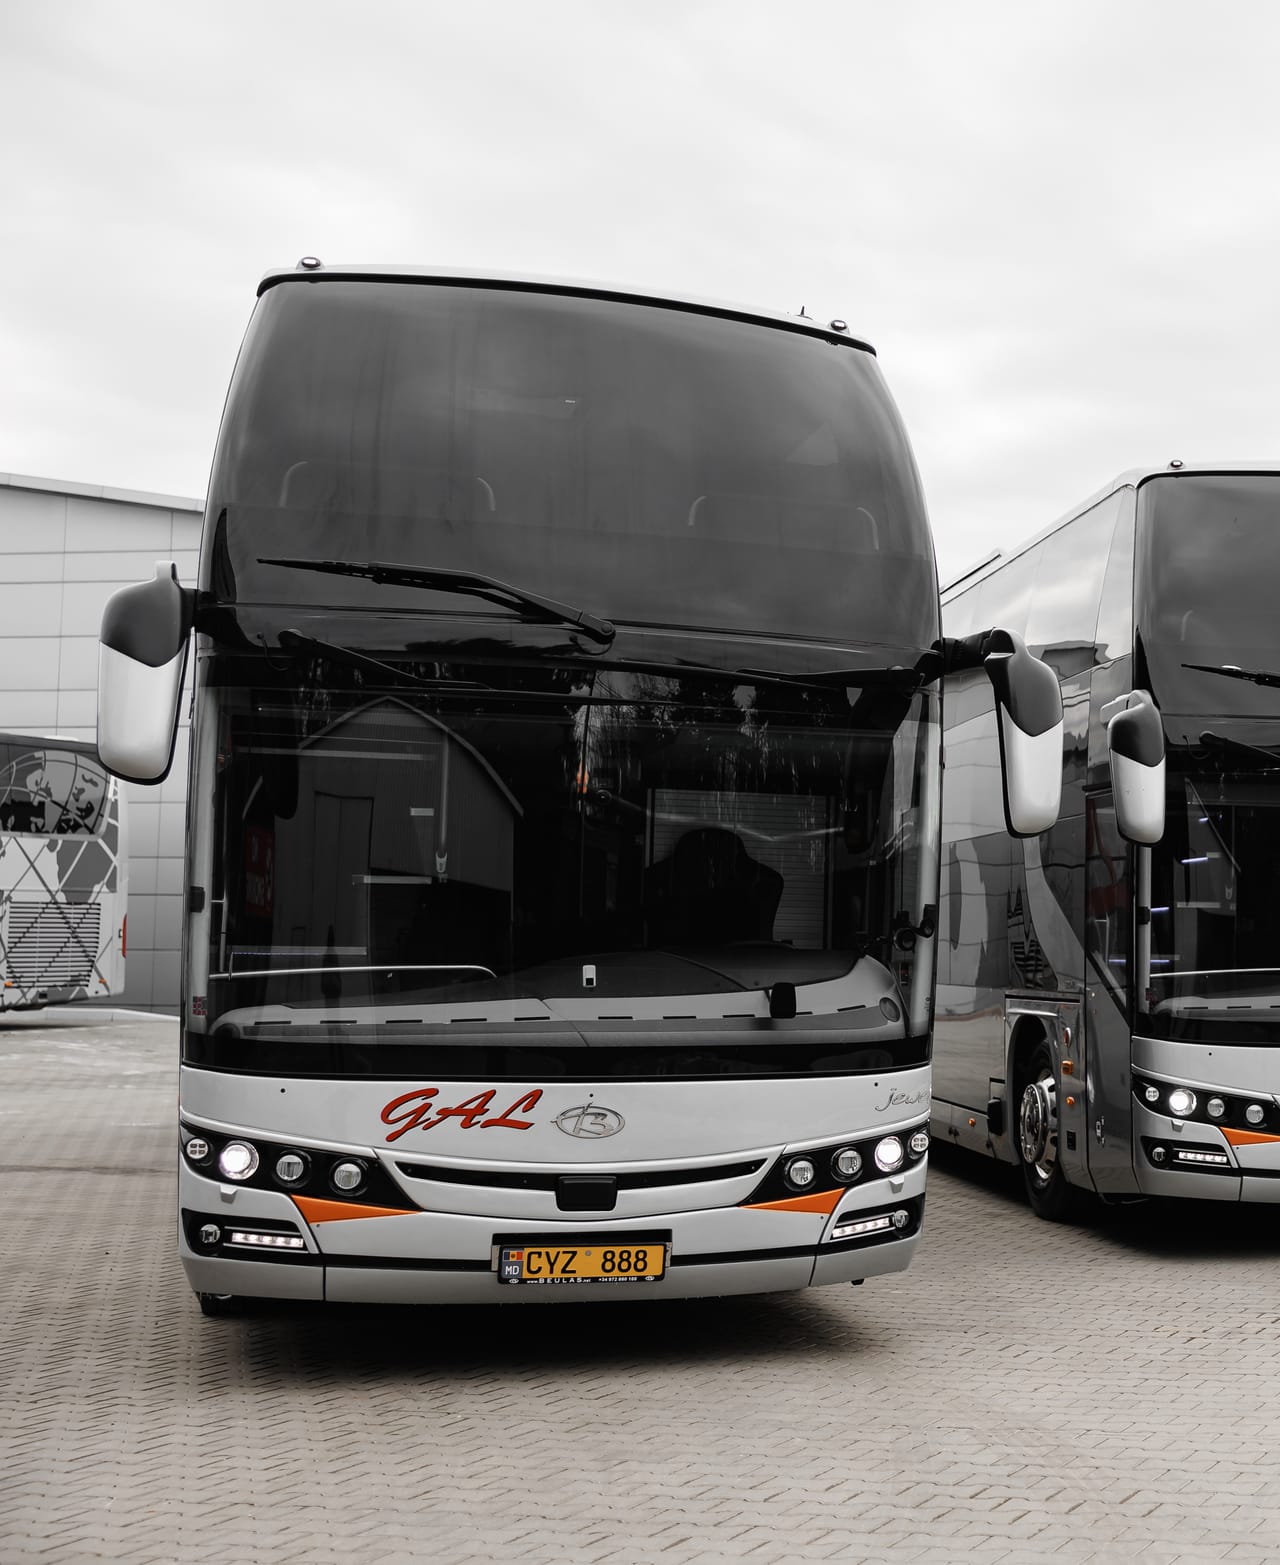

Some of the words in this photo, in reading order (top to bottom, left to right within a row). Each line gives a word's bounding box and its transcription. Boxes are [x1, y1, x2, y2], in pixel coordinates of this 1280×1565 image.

[380, 1087, 544, 1142] GAL
[505, 1265, 520, 1276] MD
[526, 1250, 578, 1275] CYZ
[601, 1249, 648, 1274] 888
